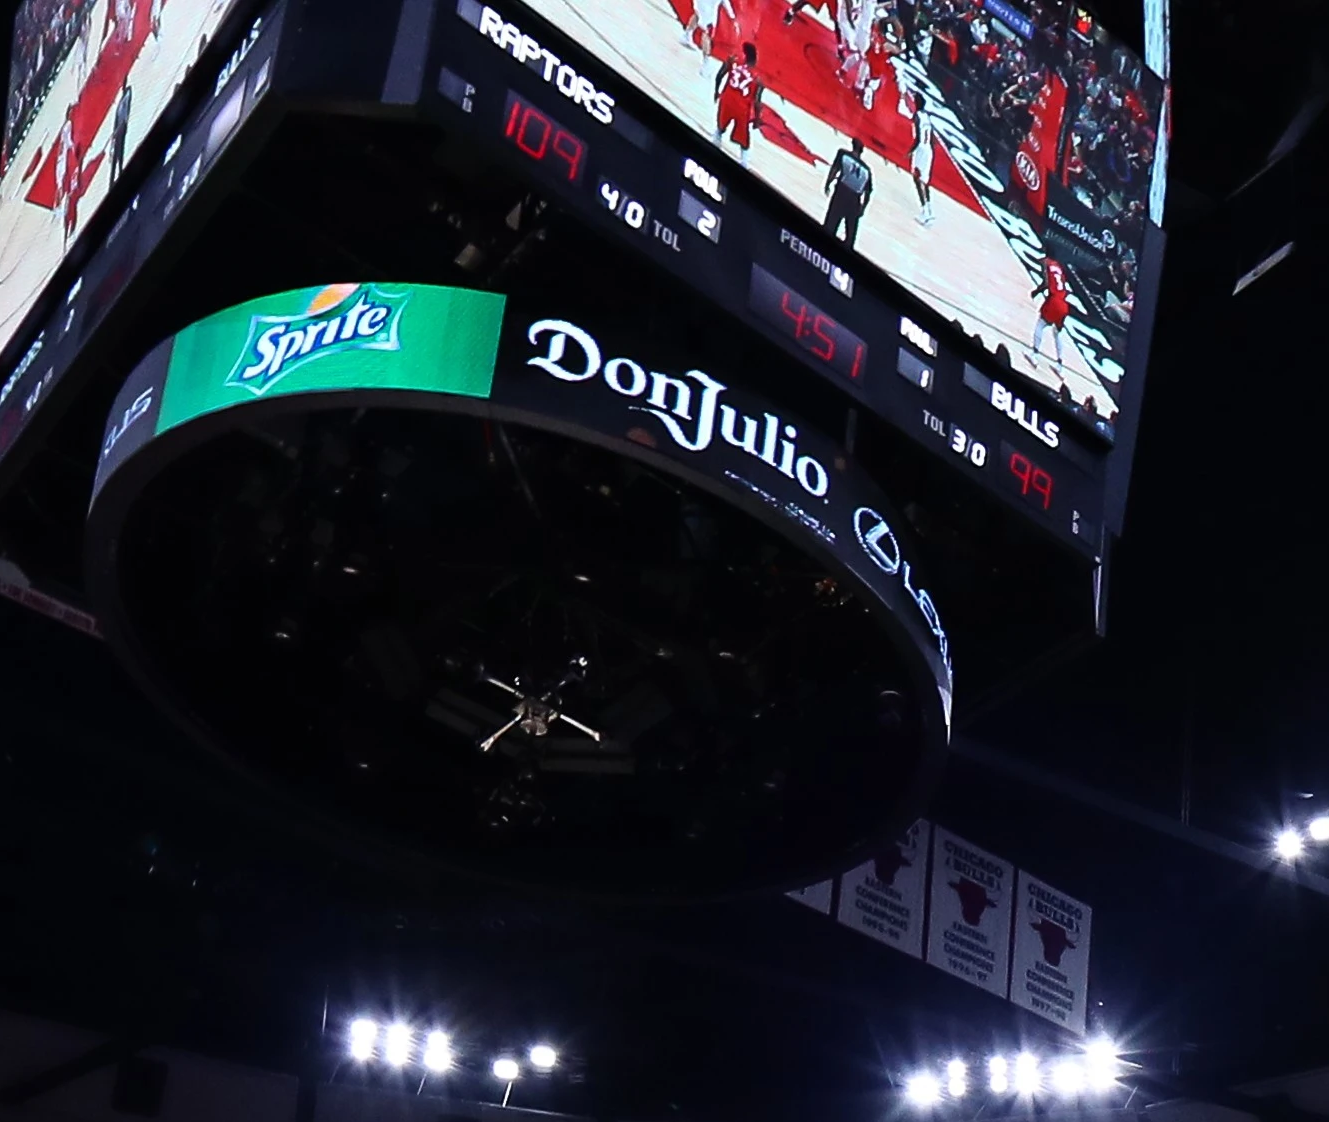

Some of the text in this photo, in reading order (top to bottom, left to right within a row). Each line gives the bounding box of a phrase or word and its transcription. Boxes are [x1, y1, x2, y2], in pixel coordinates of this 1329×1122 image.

[479, 6, 616, 125] RAPTORS
[505, 100, 584, 181] 109
[653, 219, 681, 251] TOL
[696, 209, 716, 237] 2
[780, 227, 850, 291] PERIOD 4
[242, 290, 388, 380] Sprite
[781, 292, 864, 378] 4:51
[921, 408, 947, 438] TOL
[991, 382, 1061, 449] BULLS
[1008, 452, 1054, 510] 99
[944, 838, 1005, 880] CHICAGO
[952, 860, 997, 889] BULLS
[1027, 882, 1084, 921] CHICAGO
[1035, 902, 1076, 930] BULLS
